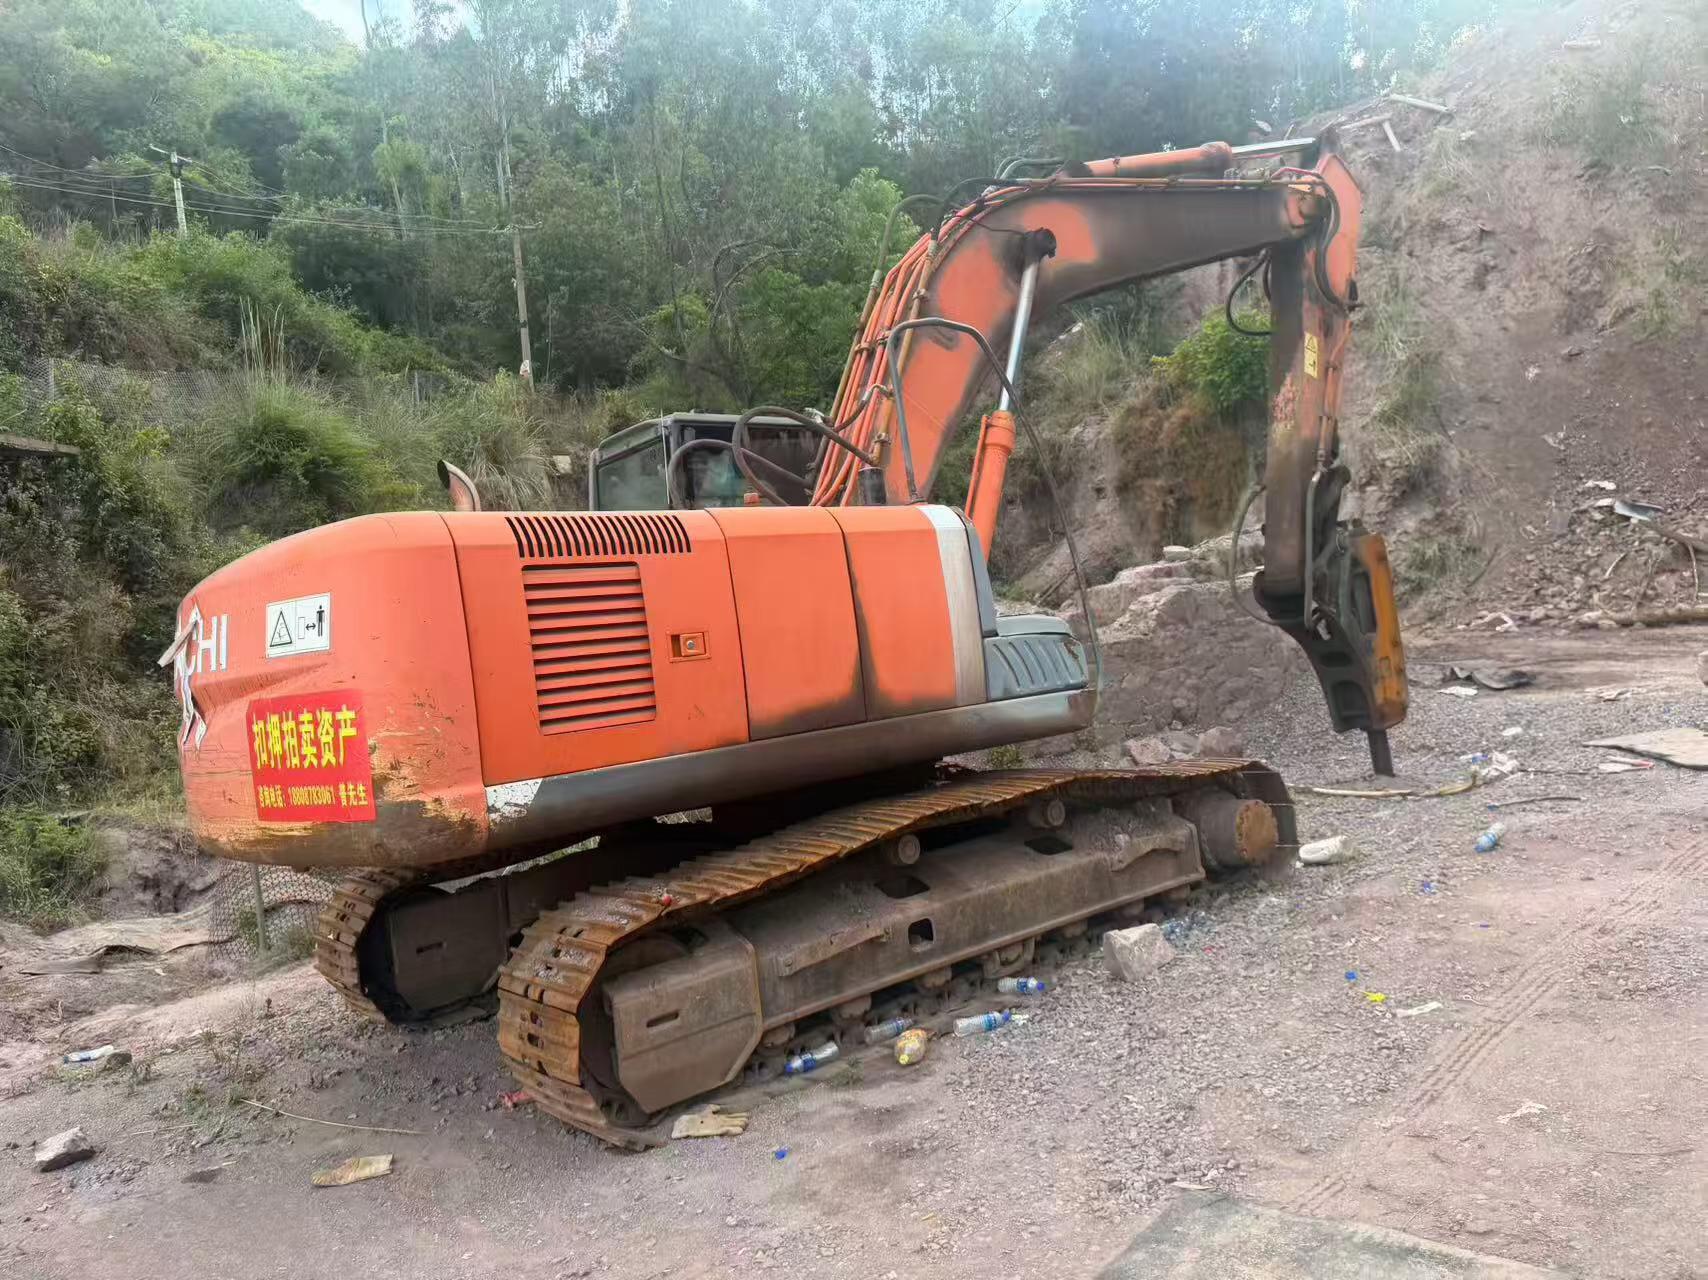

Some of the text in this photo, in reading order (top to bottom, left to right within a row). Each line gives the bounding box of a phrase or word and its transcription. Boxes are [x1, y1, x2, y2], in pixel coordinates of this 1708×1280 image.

[252, 704, 358, 769] 扣押拍卖资产
